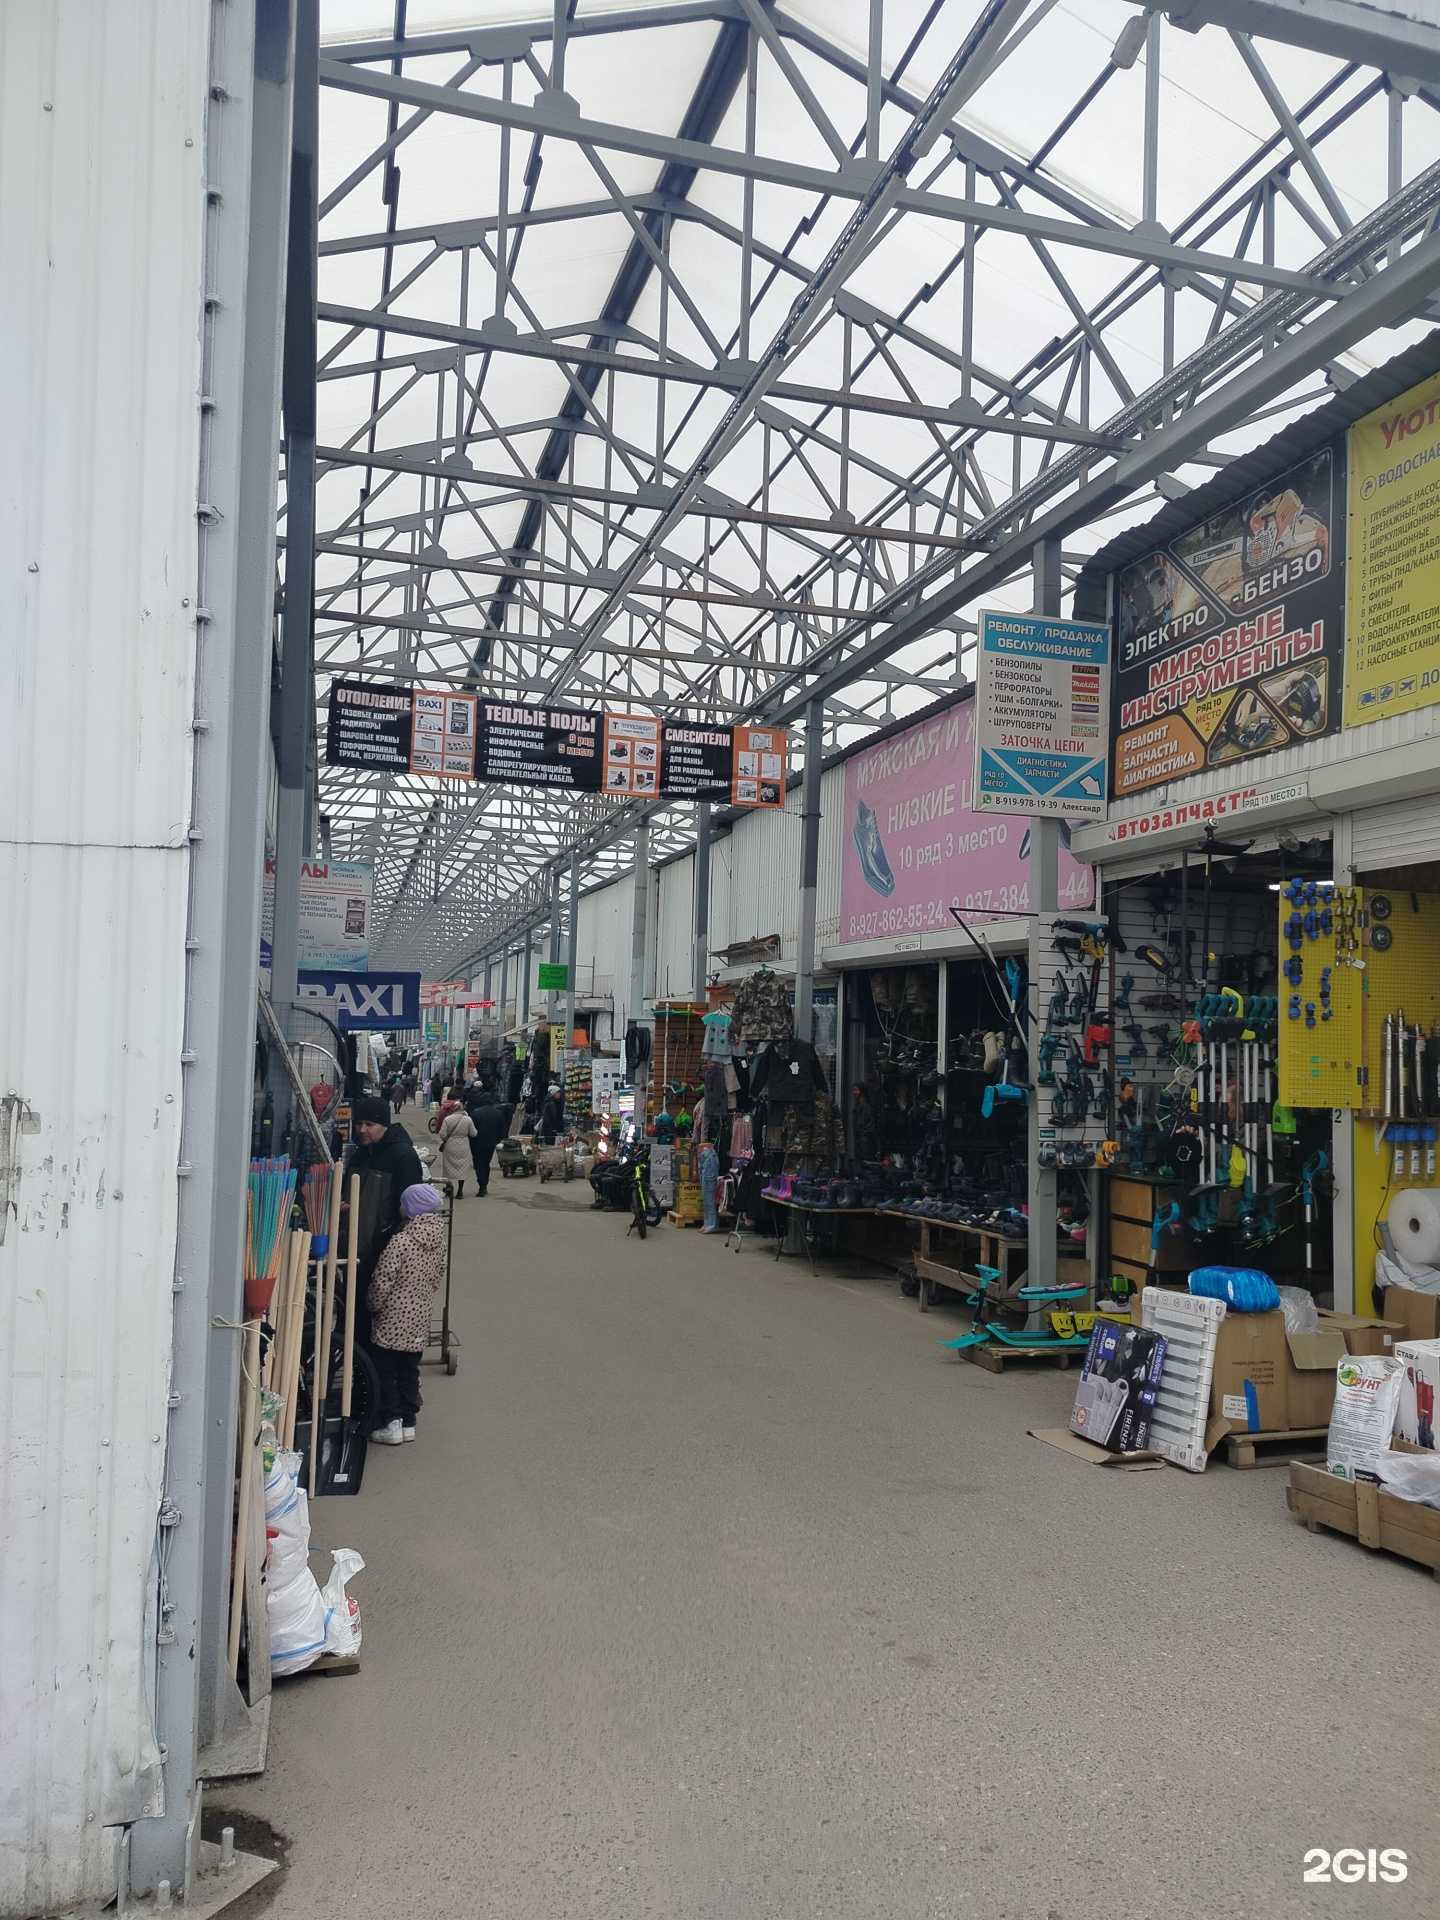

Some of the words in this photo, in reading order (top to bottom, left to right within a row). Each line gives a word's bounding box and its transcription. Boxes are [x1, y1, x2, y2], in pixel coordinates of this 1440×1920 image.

[1370, 493, 1413, 523] ГЛУБИННЫЕ
[1370, 526, 1430, 562] ВИБРАЦИОННЫЕ
[1369, 546, 1417, 576] ПОВЫШЕНИЯ
[1369, 570, 1393, 588] ТРУБЫ
[1368, 579, 1404, 601] ФИТИНГИ
[1368, 597, 1393, 615] КРАНЫ
[1367, 605, 1440, 641] ВОДОНАГРЕВАТЕЛИ
[1368, 603, 1411, 628] СМЕСИТЕЛИ
[988, 620, 1036, 637] РЕМОНТ
[1044, 626, 1104, 643] ПРОДАЖА
[1125, 605, 1209, 661] ЭЛЕКТРО
[997, 637, 1093, 658] ОБСЛУЖИВАНИЕ
[1149, 604, 1285, 692] МИРОВЫЕ
[995, 657, 1043, 671] БЕНЗОПИЛЫ
[1367, 645, 1407, 668] НАСОСНЫЕ
[995, 670, 1042, 683] БЕНЗОКОСЫ
[1121, 619, 1325, 730] ИНСТРУМЕНТЫ
[994, 682, 1052, 696] ПЕРФОРАТОРЫ
[336, 689, 411, 711] ОТОПЛЕНИЕ
[418, 699, 442, 709] BAXI
[994, 694, 1015, 705] УШМ
[1016, 696, 1063, 709] «БОЛГАРКИ»
[1196, 701, 1212, 713] РЯД
[1213, 698, 1221, 708] 10
[341, 708, 372, 719] ГАЗОВЫЕ
[373, 711, 398, 721] КОТЛЫ
[485, 704, 547, 727] ТЕПЛЫЕ
[550, 712, 596, 733] ПОЛЫ
[993, 706, 1057, 720] АККУМУЛЯТОРЫ
[1195, 708, 1221, 724] МЕСТО
[340, 720, 381, 730] РАДИАТОРЫ
[489, 726, 545, 739] ЭЛЕКТРИЧЕСКИЕ
[993, 719, 1052, 731] ШУРУПОВЕРТЫ
[340, 731, 374, 741] ШАРОВЫЕ
[375, 733, 400, 744] КРАНЫ
[489, 737, 545, 750] ИНФРАКРАСНЫЕ
[665, 728, 730, 747] СМЕСИТЕЛИ
[1000, 733, 1051, 751] ЗАТОЧКА
[1054, 738, 1085, 752] ЦЕПИ
[1124, 725, 1169, 752] РЕМОНТ
[340, 741, 397, 754] ГОФРИРОВАННАЯ
[488, 748, 522, 758] ВОДЯНЫЕ
[669, 745, 682, 753] ДЛЯ
[857, 725, 941, 790] МУЖСКАЯ
[945, 716, 959, 751] И
[1123, 741, 1179, 770] ЗАПЧАСТИ
[363, 752, 407, 764] НЕРЖАВЕЙКА
[488, 758, 572, 774] САМОРЕГУЛИРУЮЩИЙСЯ
[669, 756, 682, 764] ДЛЯ
[1016, 757, 1067, 769] ДИАГНОСТИКА
[487, 767, 548, 780] НАГРЕВАТЕЛЬНЫЙ
[549, 774, 575, 783] КАБЕЛЬ
[669, 765, 683, 774] ДЛЯ
[1023, 768, 1060, 779] ЗАПЧАСТИ
[1122, 753, 1196, 787] ДИАГНОСТИКА
[668, 775, 697, 785] ФИЛЬТРЫ
[1270, 788, 1296, 802] МЕСТО
[888, 783, 955, 834] НИЗКИЕ
[1061, 801, 1101, 813] Александр
[899, 845, 912, 870] 10
[916, 836, 942, 873] ряд
[945, 832, 954, 858] 3
[958, 823, 1008, 855] место
